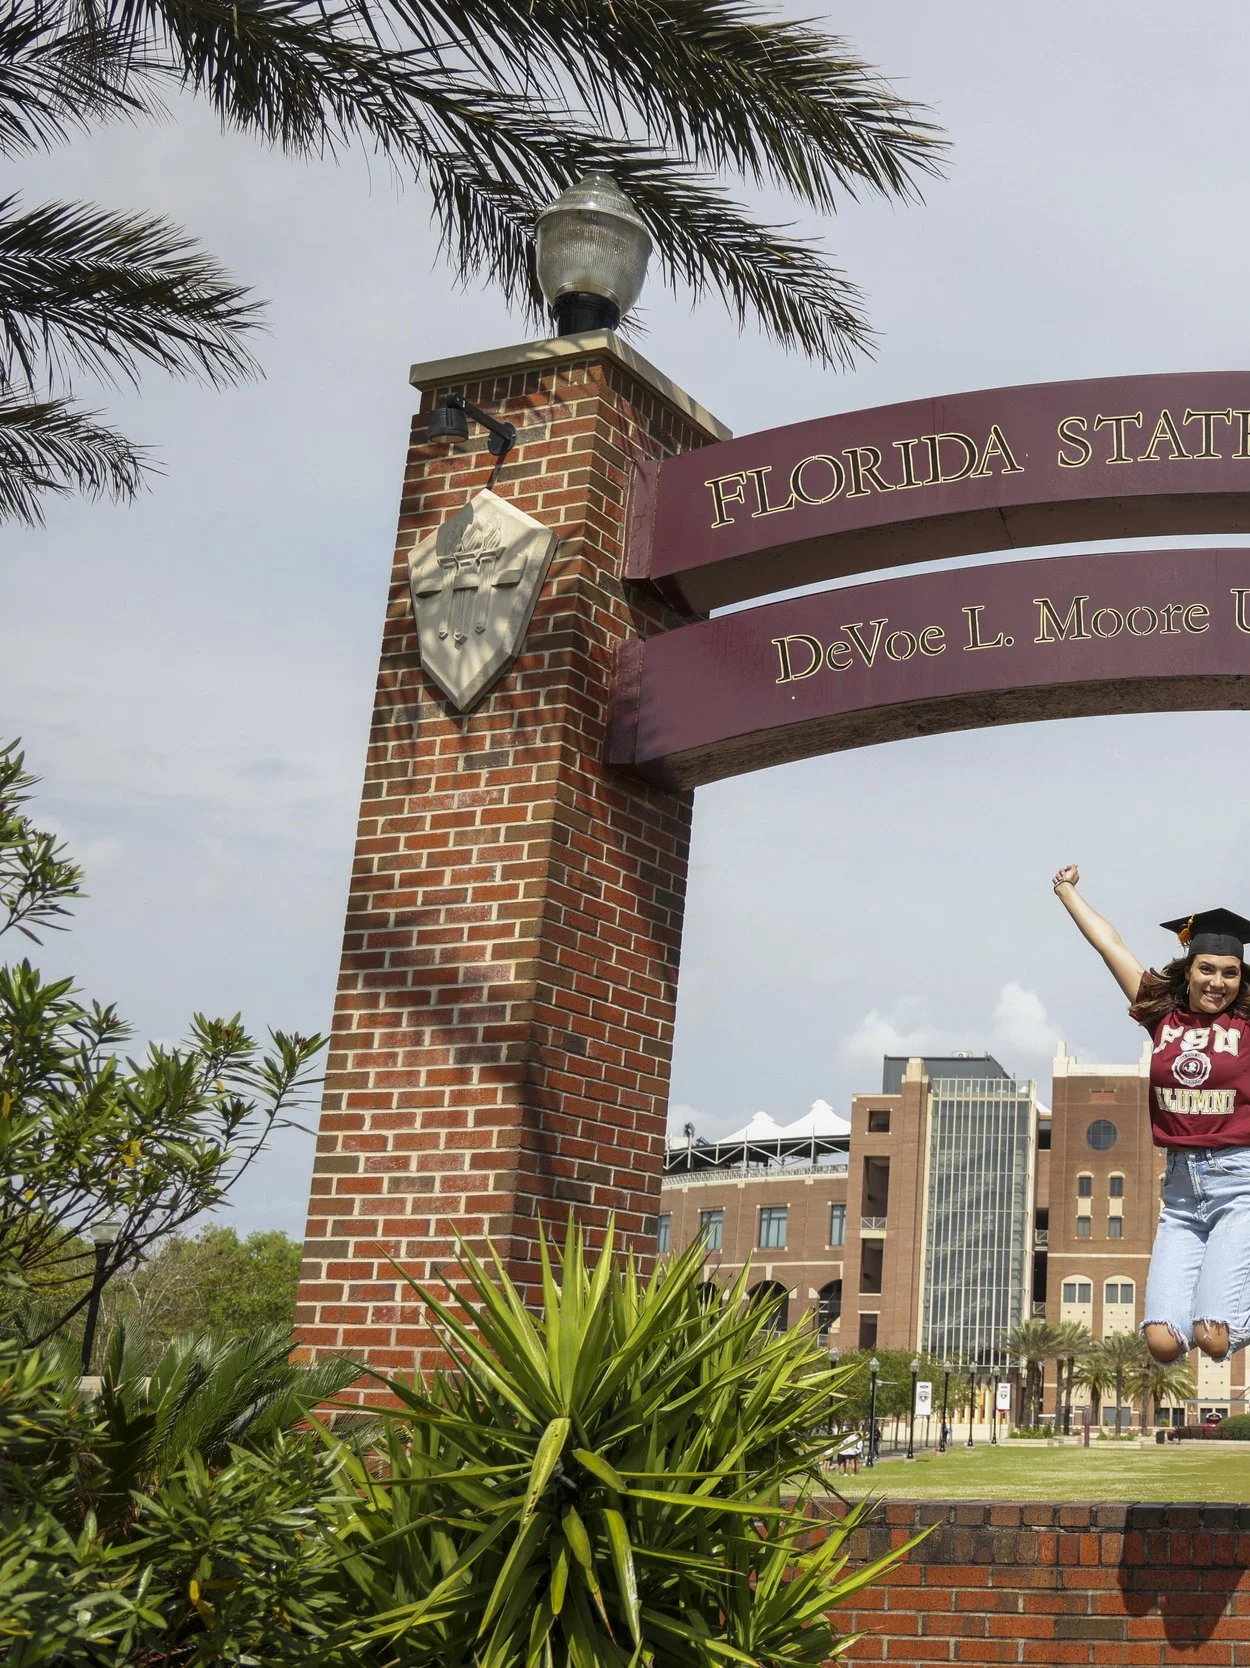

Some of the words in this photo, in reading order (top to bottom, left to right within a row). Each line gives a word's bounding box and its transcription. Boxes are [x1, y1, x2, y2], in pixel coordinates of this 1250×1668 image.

[704, 424, 1025, 528] FLORIDA
[771, 618, 946, 684] DeVoe
[962, 605, 1015, 652] L.
[1033, 595, 1210, 645] Moore
[1152, 1023, 1241, 1057] FSU
